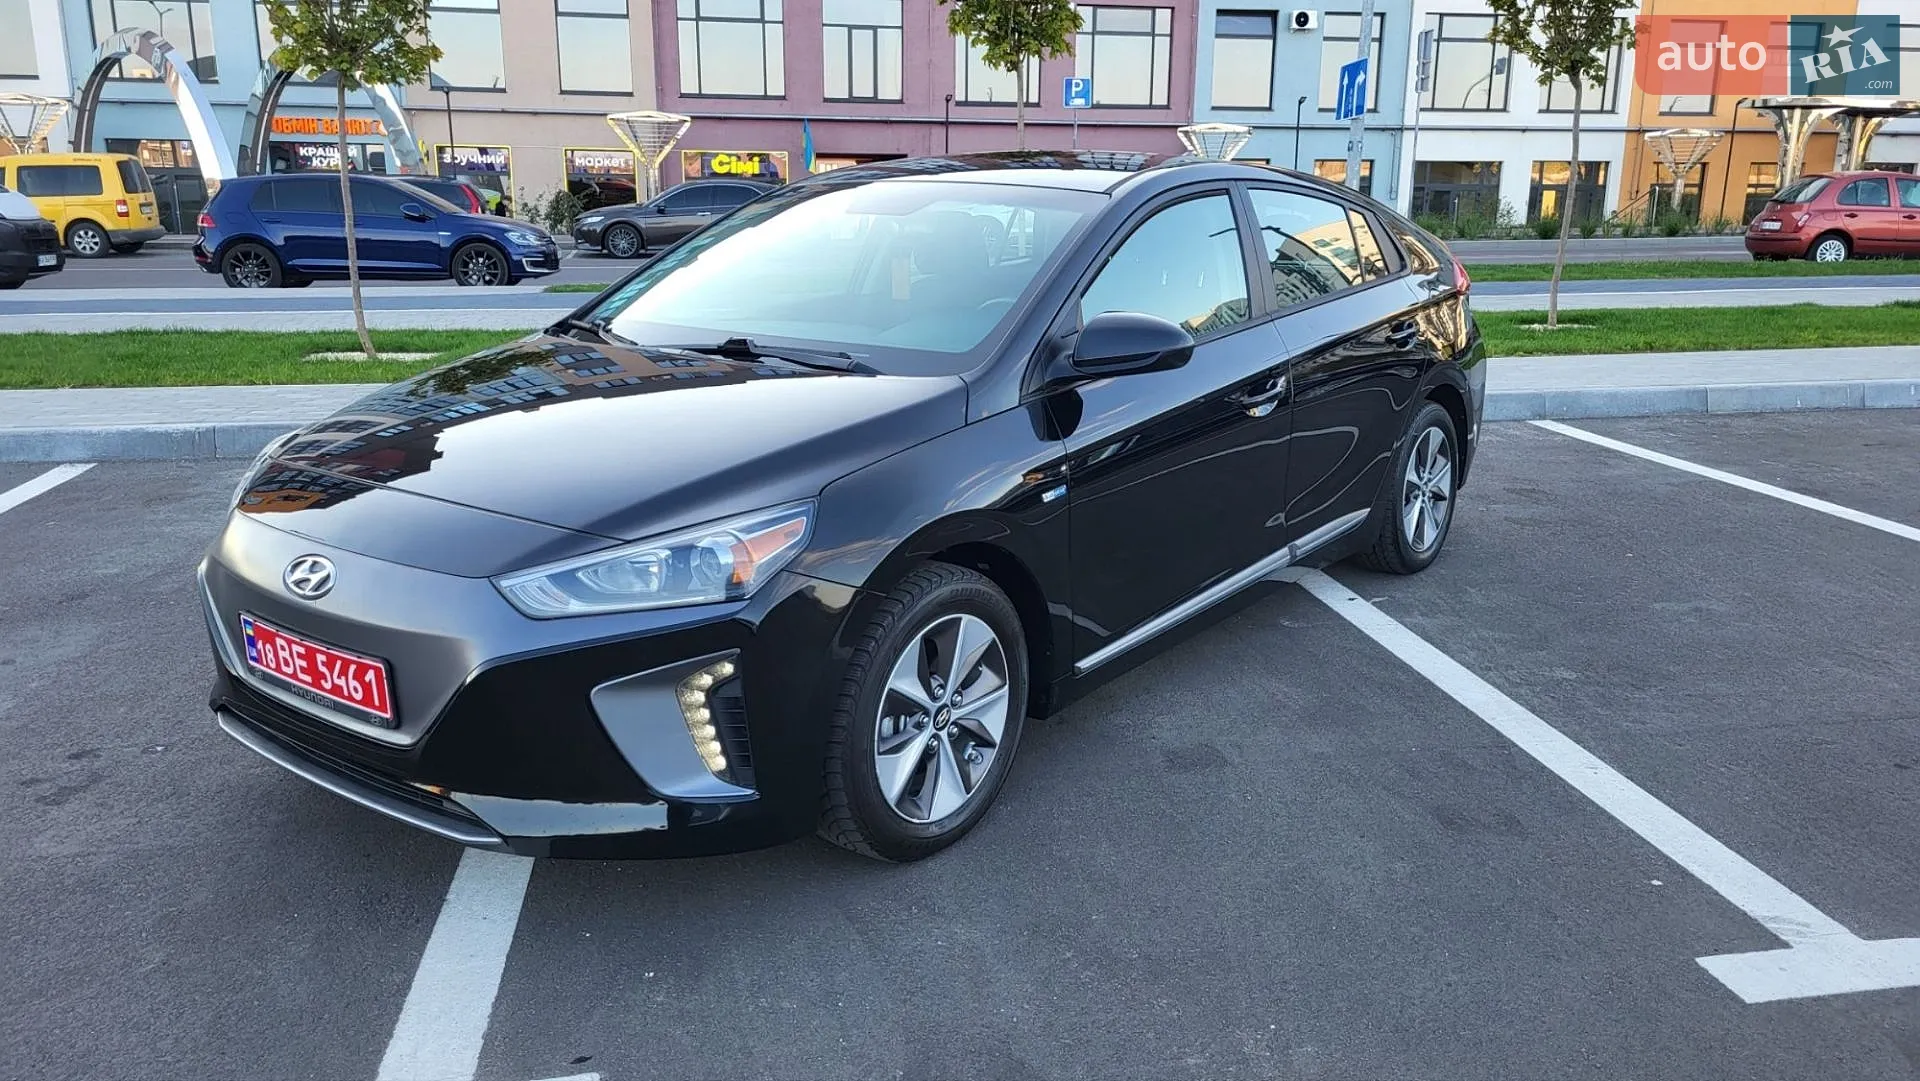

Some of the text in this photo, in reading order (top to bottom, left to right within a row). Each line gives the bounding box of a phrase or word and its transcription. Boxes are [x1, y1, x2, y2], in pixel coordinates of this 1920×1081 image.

[1071, 79, 1084, 98] P
[271, 117, 318, 135] ОБМІН
[299, 146, 358, 158] КРАЩЙ
[311, 157, 342, 168] КУР
[575, 157, 625, 169] маркет
[710, 153, 761, 175] Сімі
[316, 653, 380, 707] 5461
